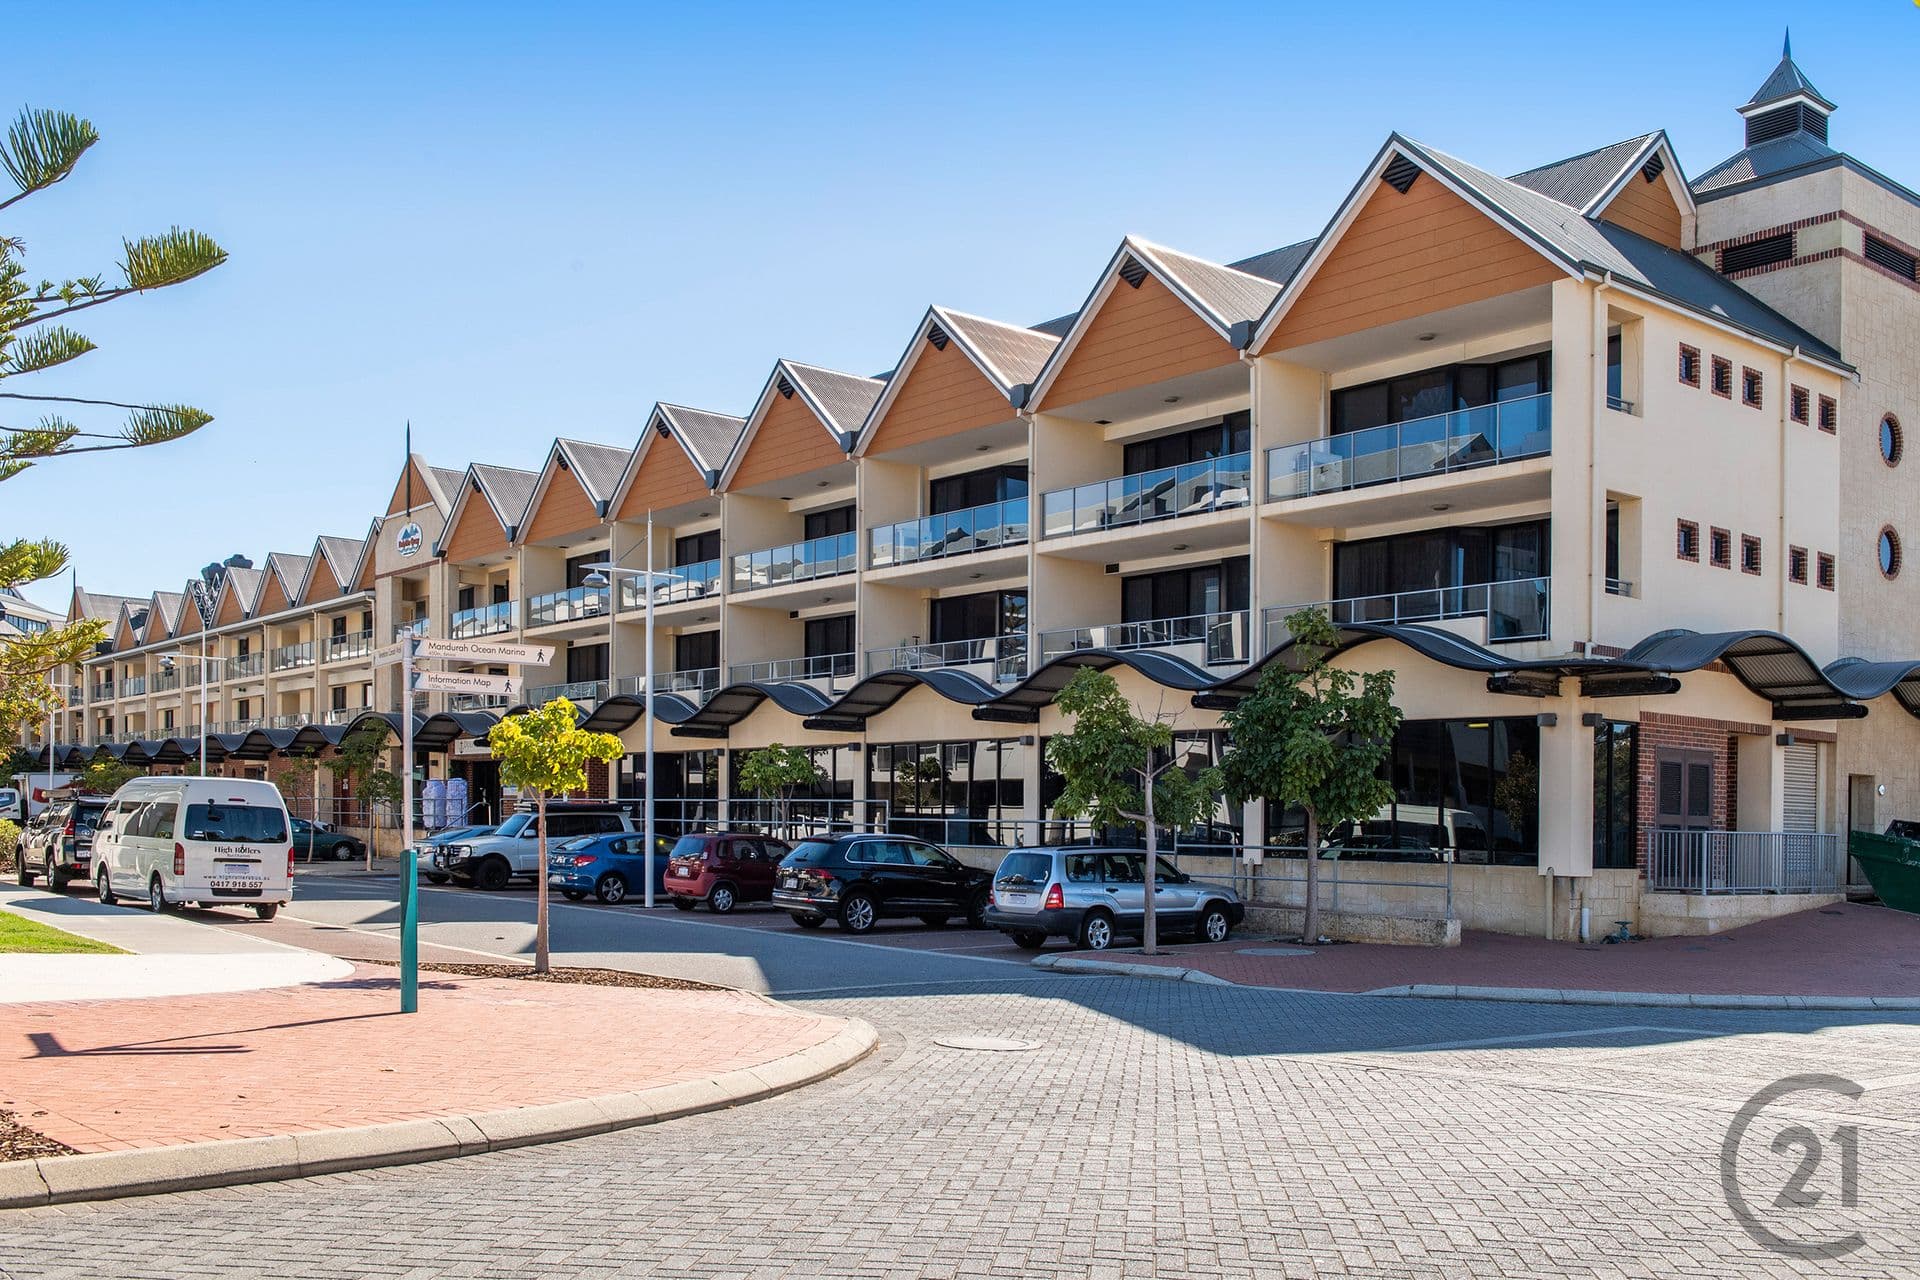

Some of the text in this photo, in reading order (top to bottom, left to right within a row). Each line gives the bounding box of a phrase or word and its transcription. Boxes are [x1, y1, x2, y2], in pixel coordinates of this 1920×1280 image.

[428, 642, 526, 656] Mandurah Ocean Marina
[428, 674, 491, 688] Information Map
